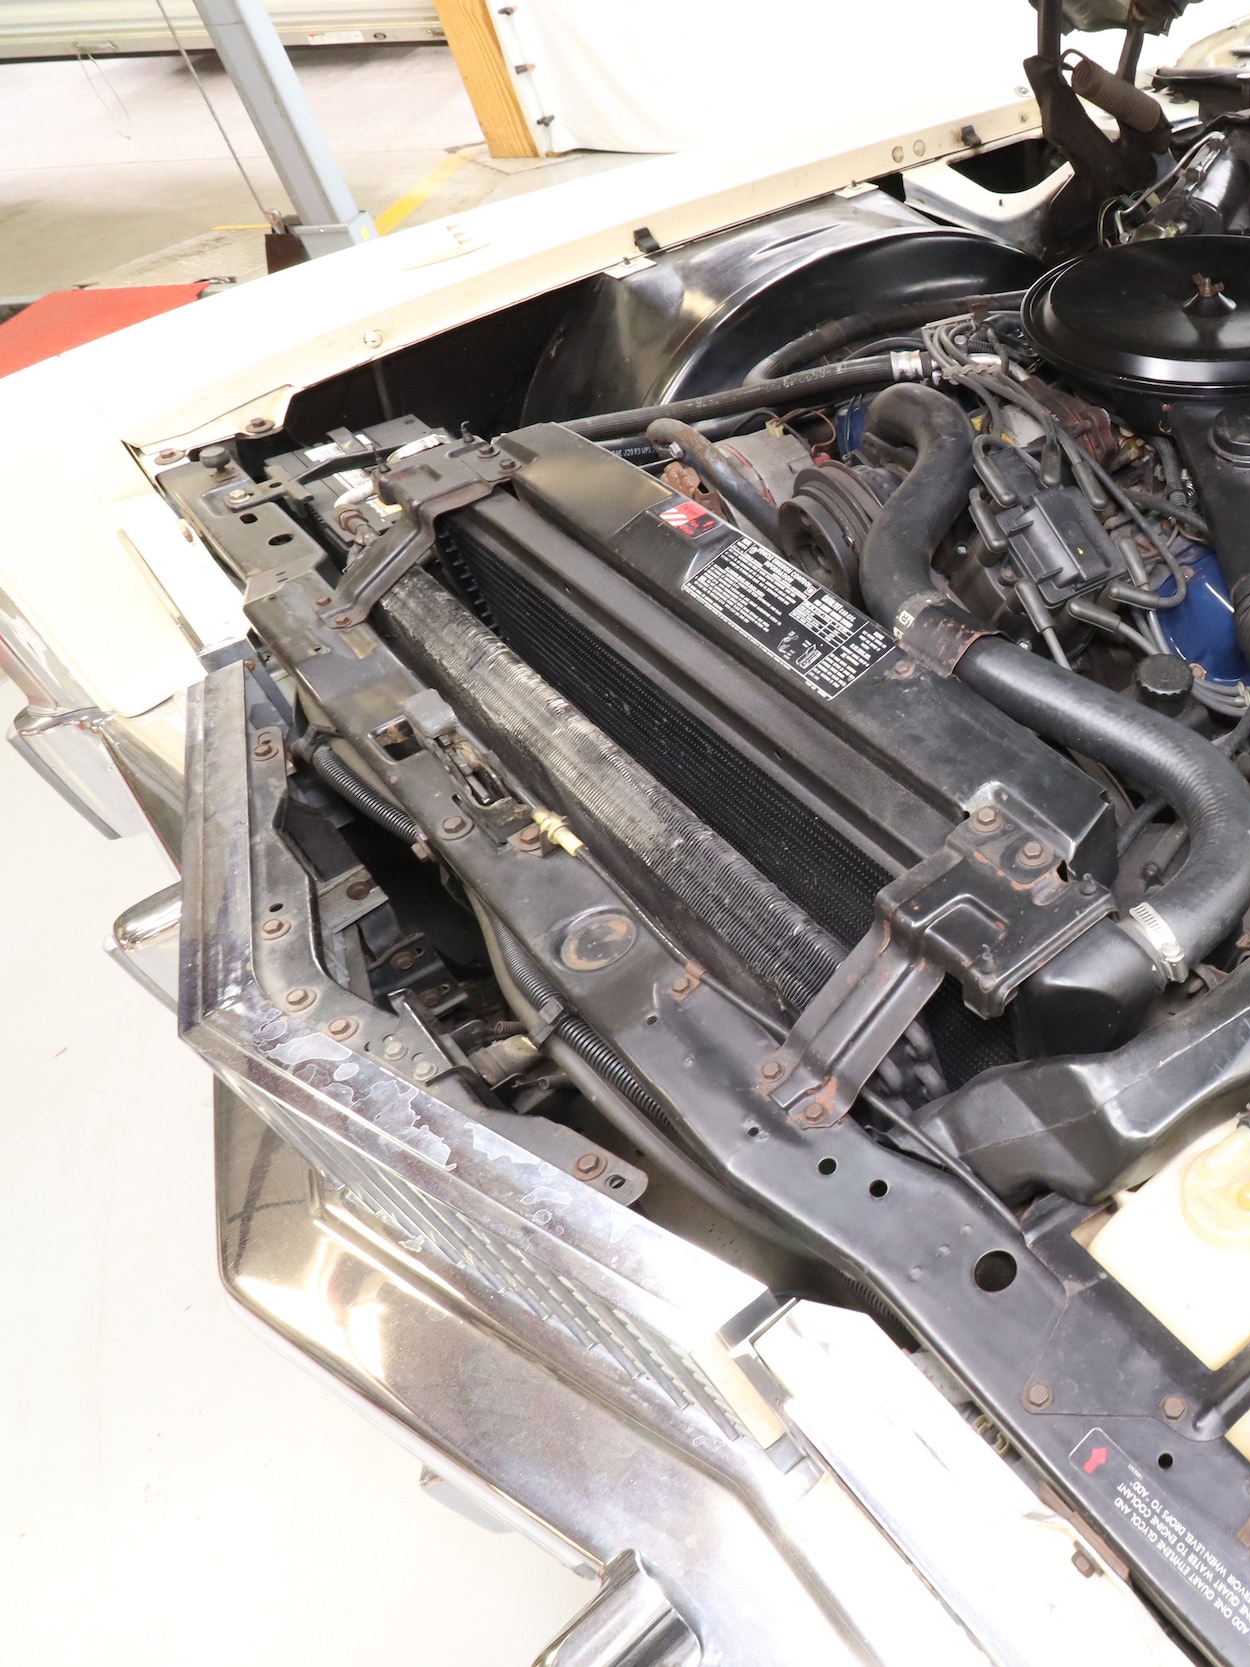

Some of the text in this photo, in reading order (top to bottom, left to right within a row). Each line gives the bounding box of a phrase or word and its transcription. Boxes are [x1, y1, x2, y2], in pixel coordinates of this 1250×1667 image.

[790, 569, 812, 588] CONTROL
[1117, 1483, 1151, 1518] COOLANT
[1151, 1499, 1163, 1513] TO
[1150, 1515, 1178, 1545] ENGINE
[1161, 1510, 1186, 1536] DROPS
[1176, 1542, 1188, 1557] TO
[1185, 1531, 1206, 1555] LEVEL
[1114, 1497, 1250, 1634] ADD ONE QUART ETHYLENE GLYCOL AND
[1187, 1552, 1213, 1582] WATER
[1203, 1551, 1227, 1578] WHEN
[1213, 1579, 1240, 1607] QUART
